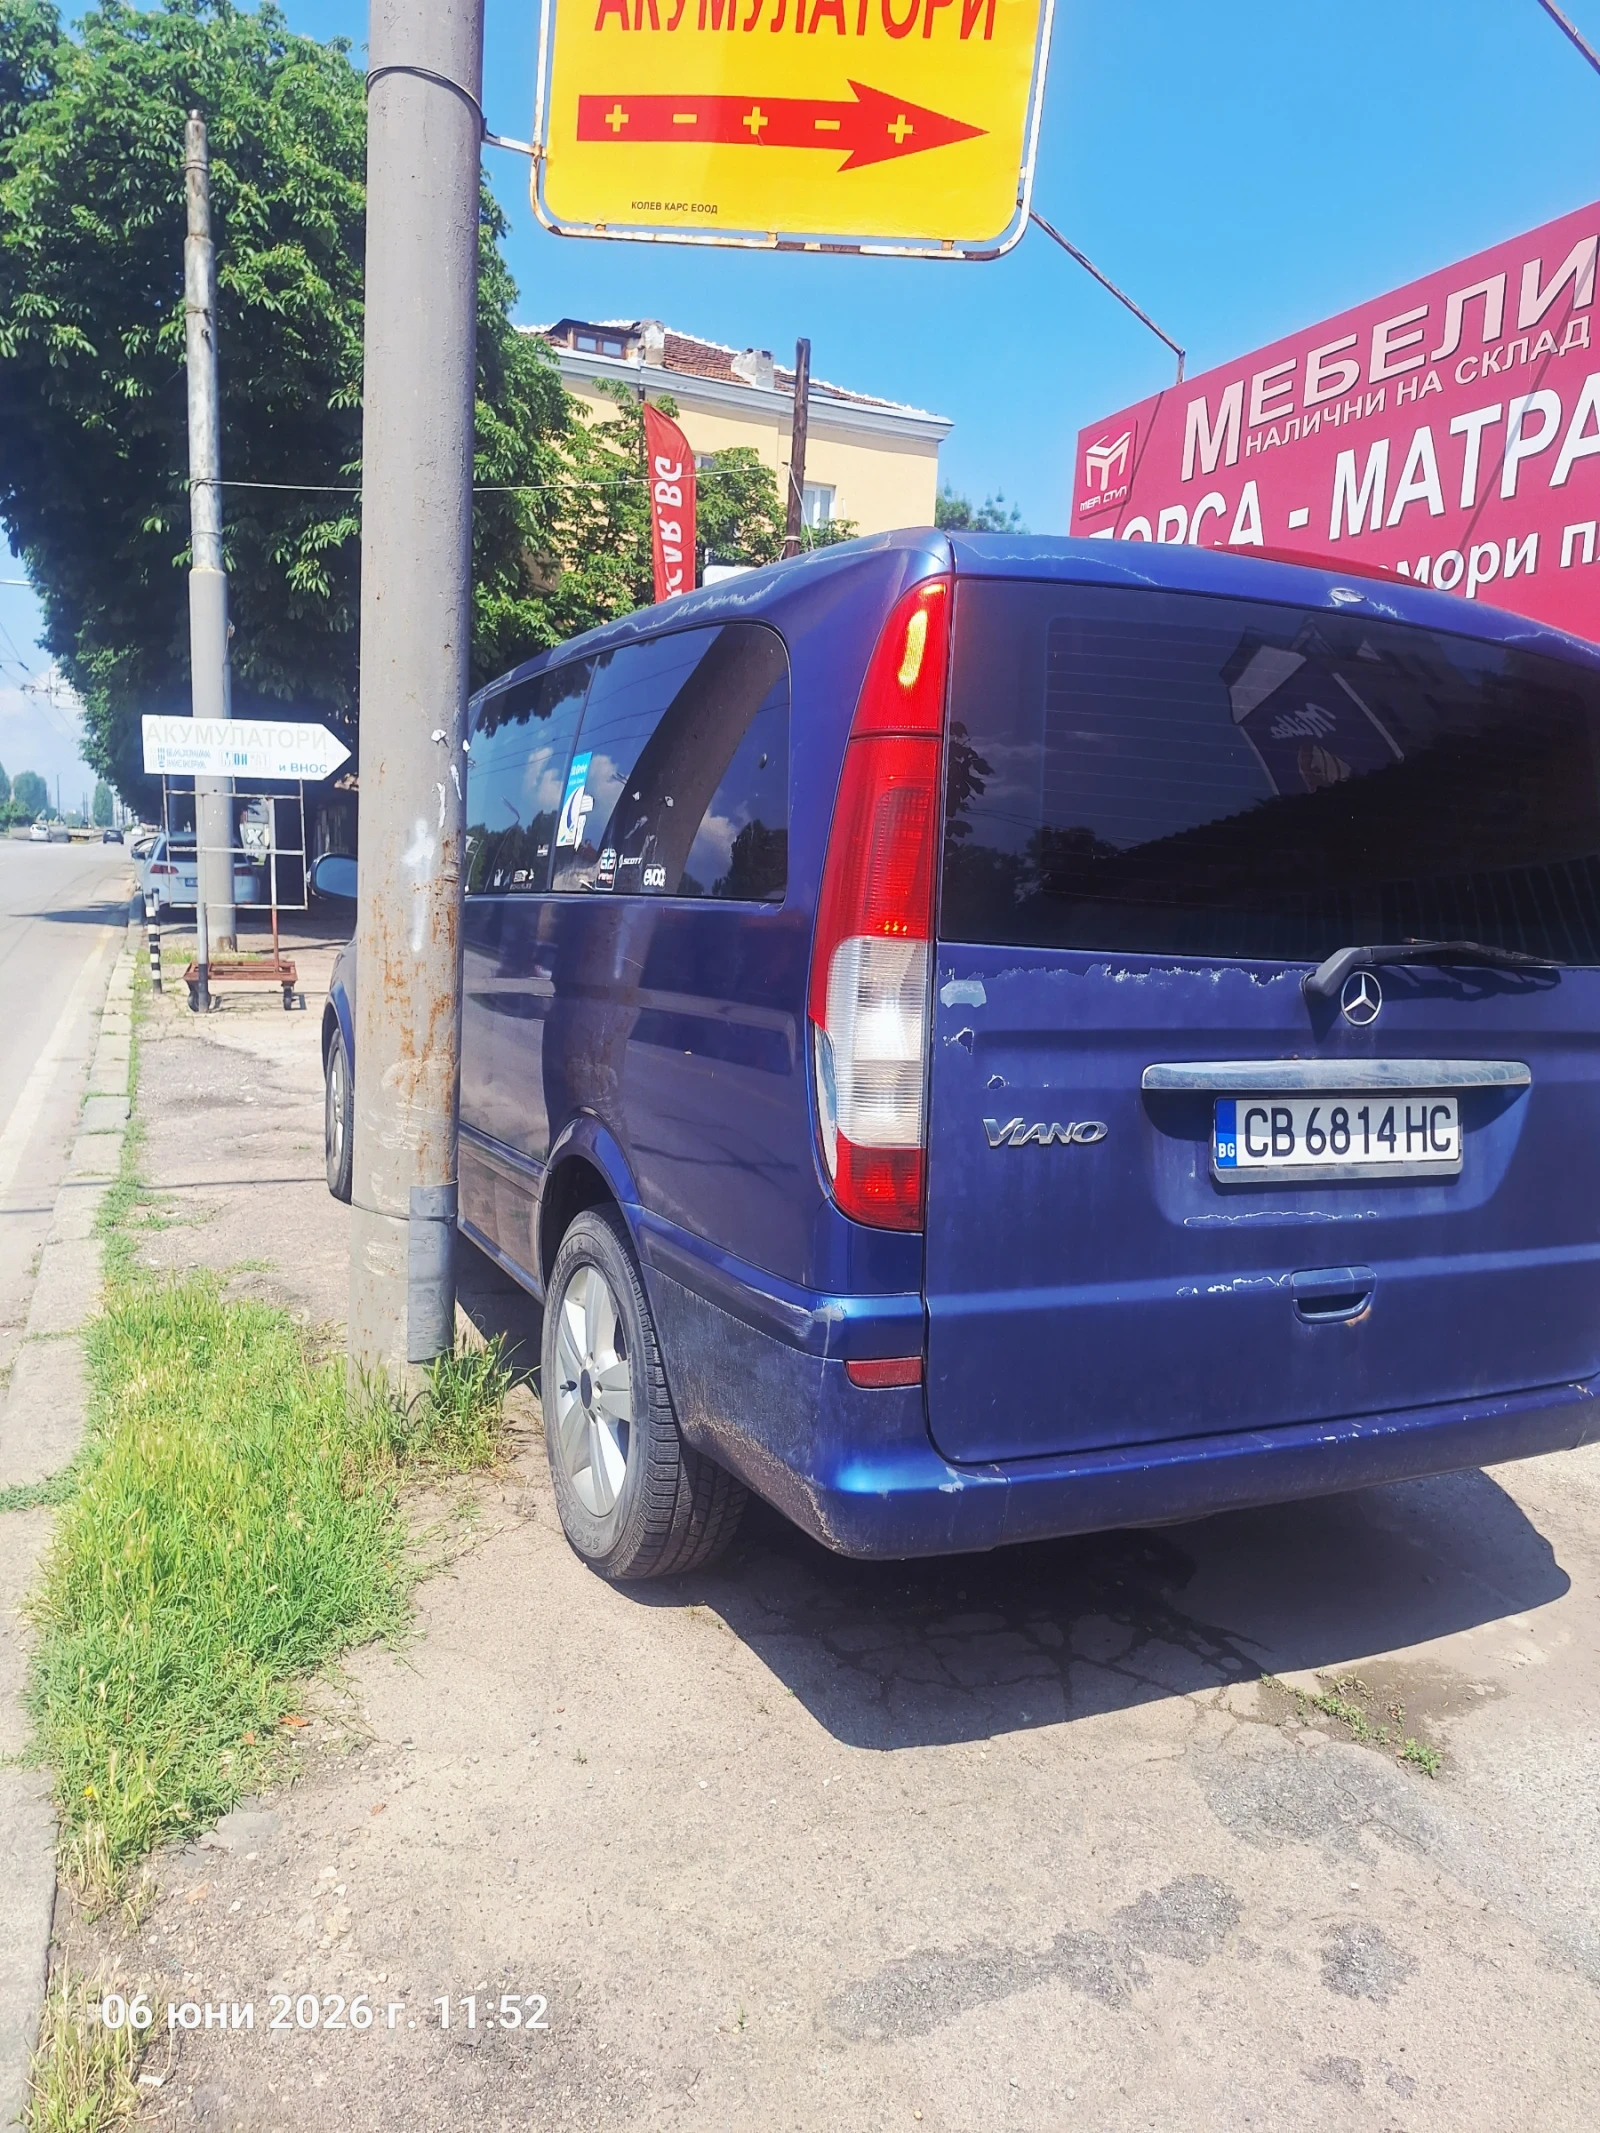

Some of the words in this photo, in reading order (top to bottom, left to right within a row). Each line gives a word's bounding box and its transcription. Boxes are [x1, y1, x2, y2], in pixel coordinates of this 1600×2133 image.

[631, 200, 662, 212] КОЛЕВ
[664, 202, 689, 213] КАРС
[691, 203, 718, 214] ЕООД
[1180, 234, 1599, 482] МЕБЕЛИ
[1245, 383, 1386, 457] НАЛИЧНИ
[1396, 369, 1444, 406] НА
[1455, 315, 1591, 386] СКЛАД
[1377, 532, 1540, 599] мори
[145, 721, 328, 751] АКУМУЛАТОРИ
[291, 763, 328, 774] ВНОС
[623, 857, 643, 865] SCOTT
[982, 1117, 1108, 1147] VIANO
[1218, 1143, 1235, 1158] BG
[1243, 1107, 1296, 1158] CB
[1305, 1106, 1397, 1155] 6814
[1406, 1104, 1452, 1152] HC
